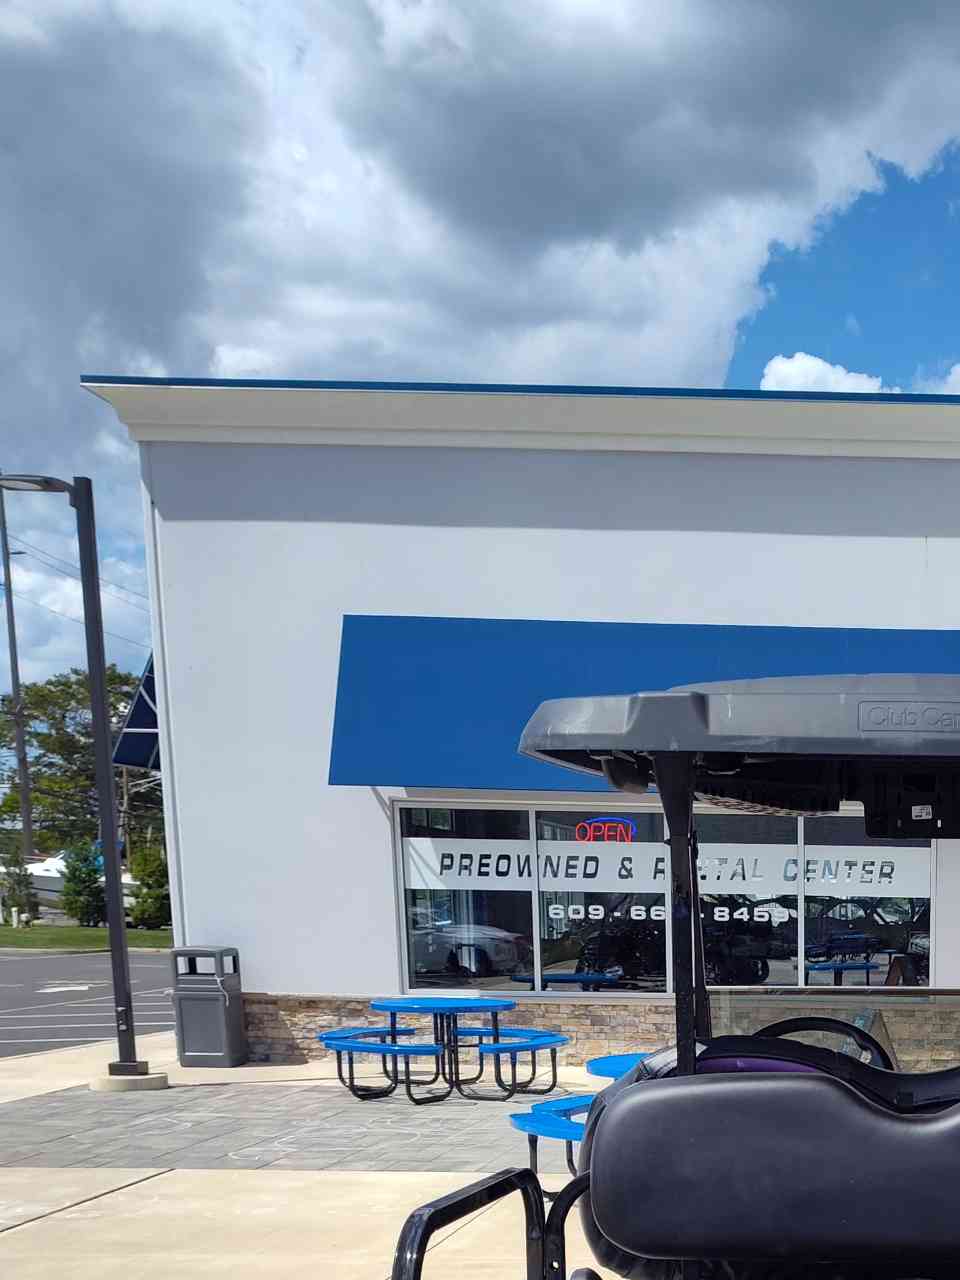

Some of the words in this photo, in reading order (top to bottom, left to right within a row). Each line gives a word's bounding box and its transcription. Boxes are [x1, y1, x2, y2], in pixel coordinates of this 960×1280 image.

[869, 704, 919, 727] Club
[575, 822, 632, 844] OPEN
[439, 852, 600, 880] PREOWNED
[617, 857, 634, 879] &
[783, 857, 896, 884] CENTER
